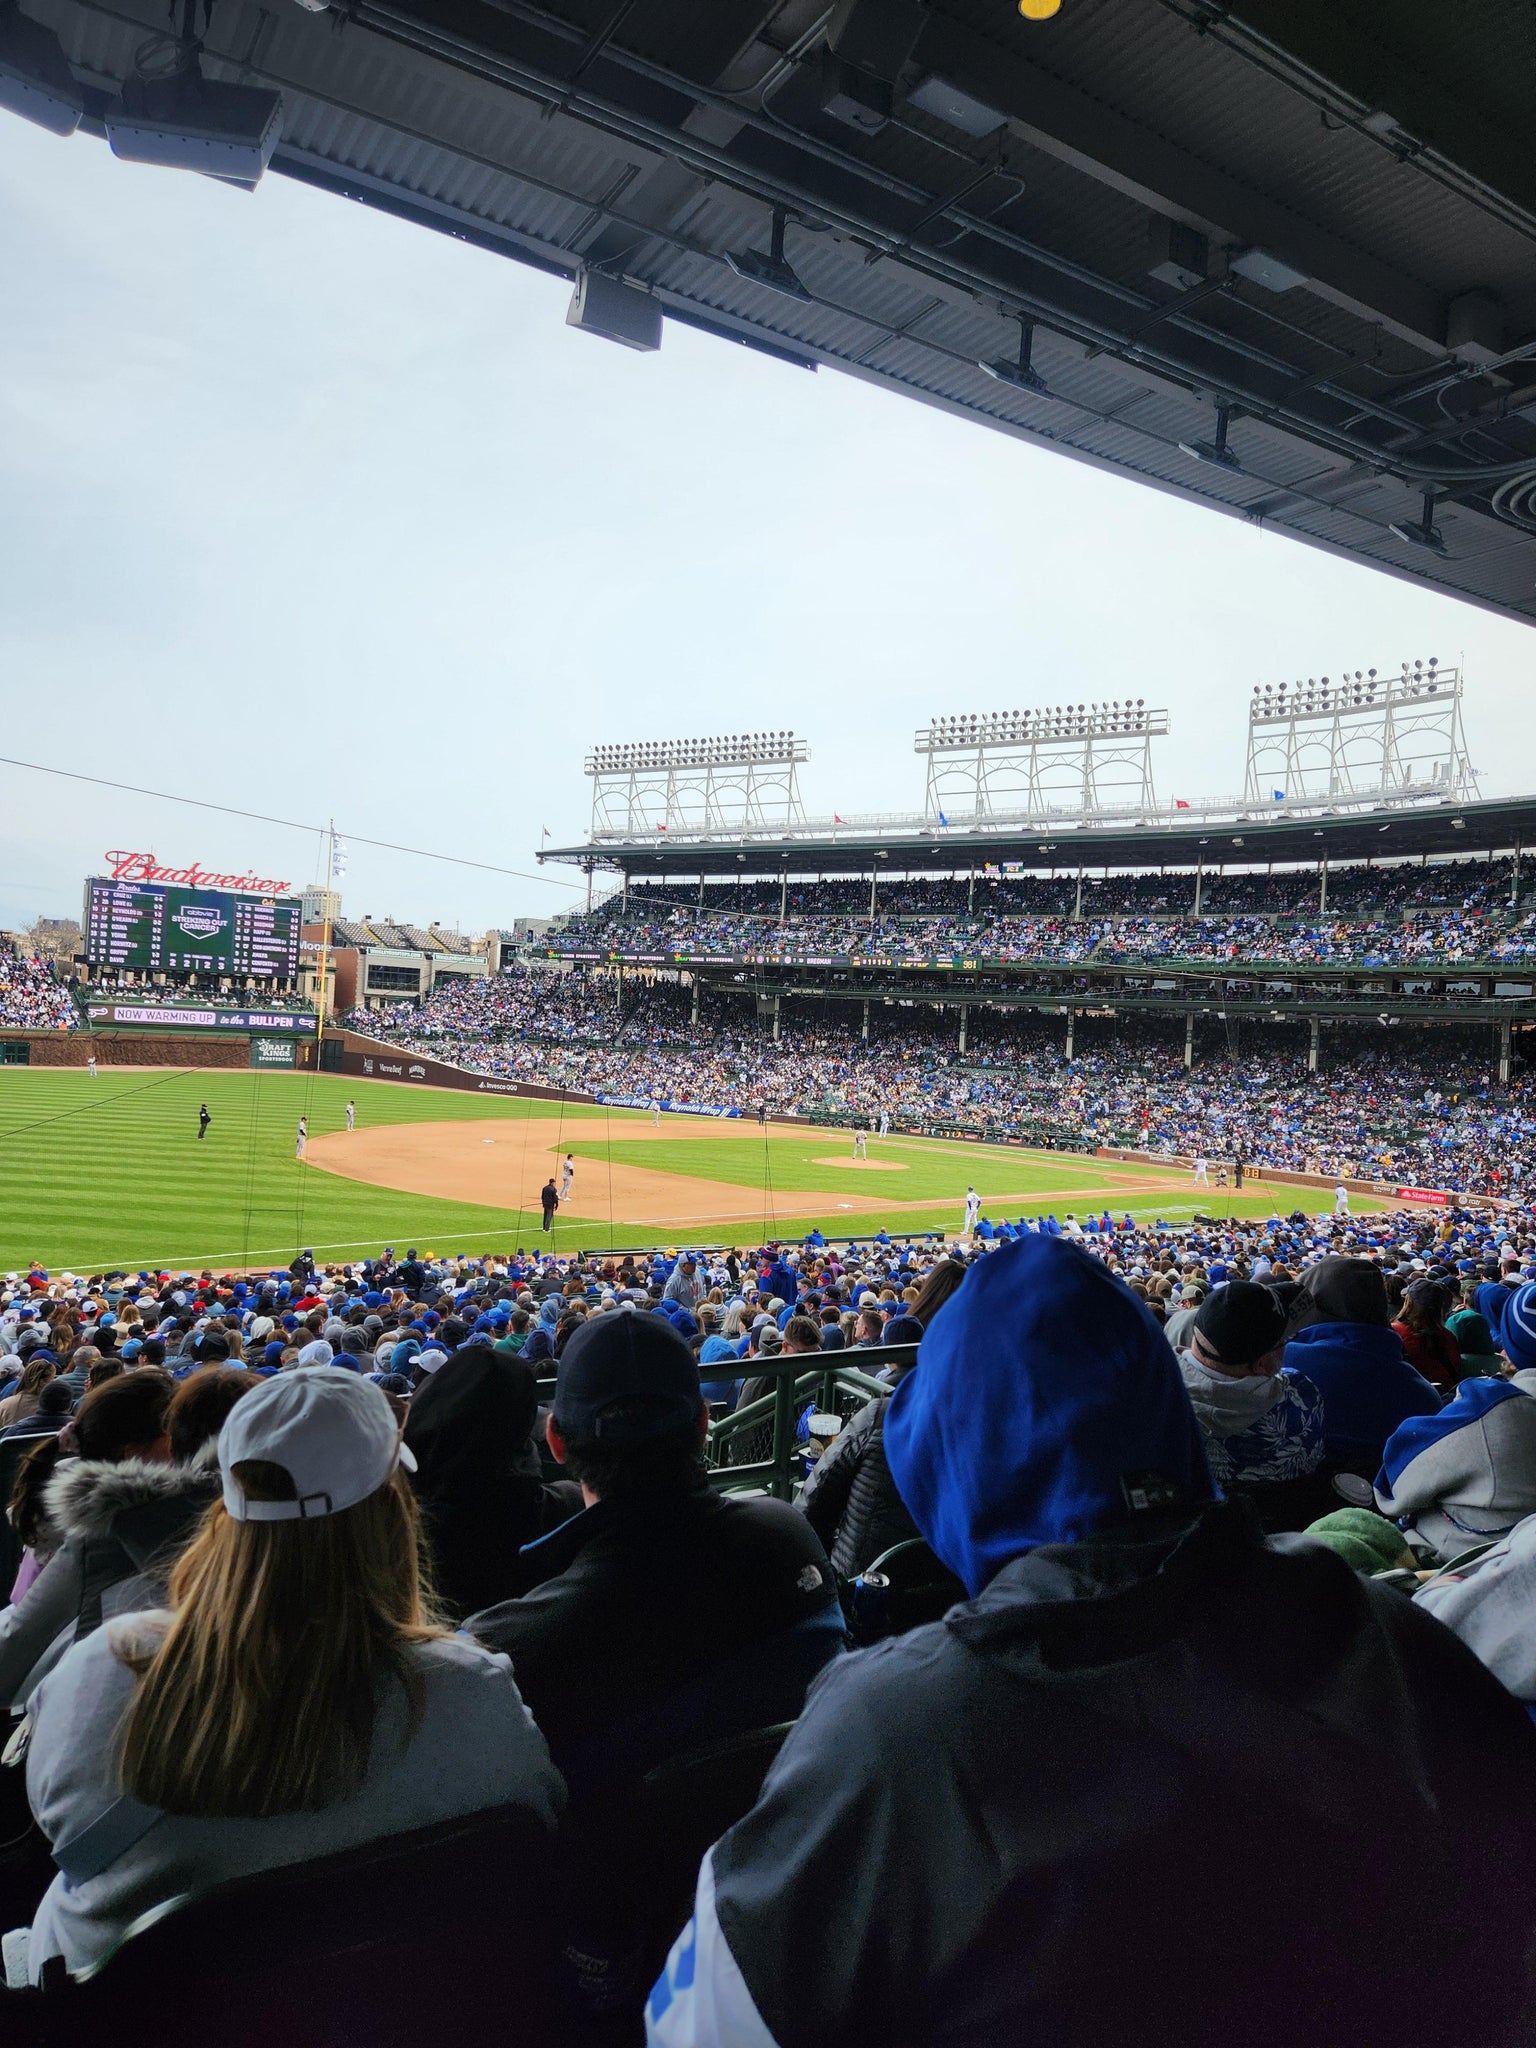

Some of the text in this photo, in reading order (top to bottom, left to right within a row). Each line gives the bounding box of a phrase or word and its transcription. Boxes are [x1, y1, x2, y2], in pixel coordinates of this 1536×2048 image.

[104, 850, 292, 893] Budweiser
[117, 882, 141, 892] Pirates
[172, 916, 210, 925] STRIKING
[184, 923, 216, 931] CANCER
[169, 958, 176, 966] 2
[204, 961, 211, 969] 2
[218, 962, 224, 970] 3
[117, 1010, 142, 1020] NOW
[145, 1010, 196, 1022] WARMING
[199, 1013, 213, 1023] UP
[230, 1015, 244, 1025] the
[249, 1015, 293, 1027] BULLPEN
[487, 1082, 505, 1090] Invesco
[602, 1097, 649, 1108] Reynolds Wrap
[669, 1103, 720, 1116] Reynolds Wrap
[1412, 1192, 1444, 1202] State Farm
